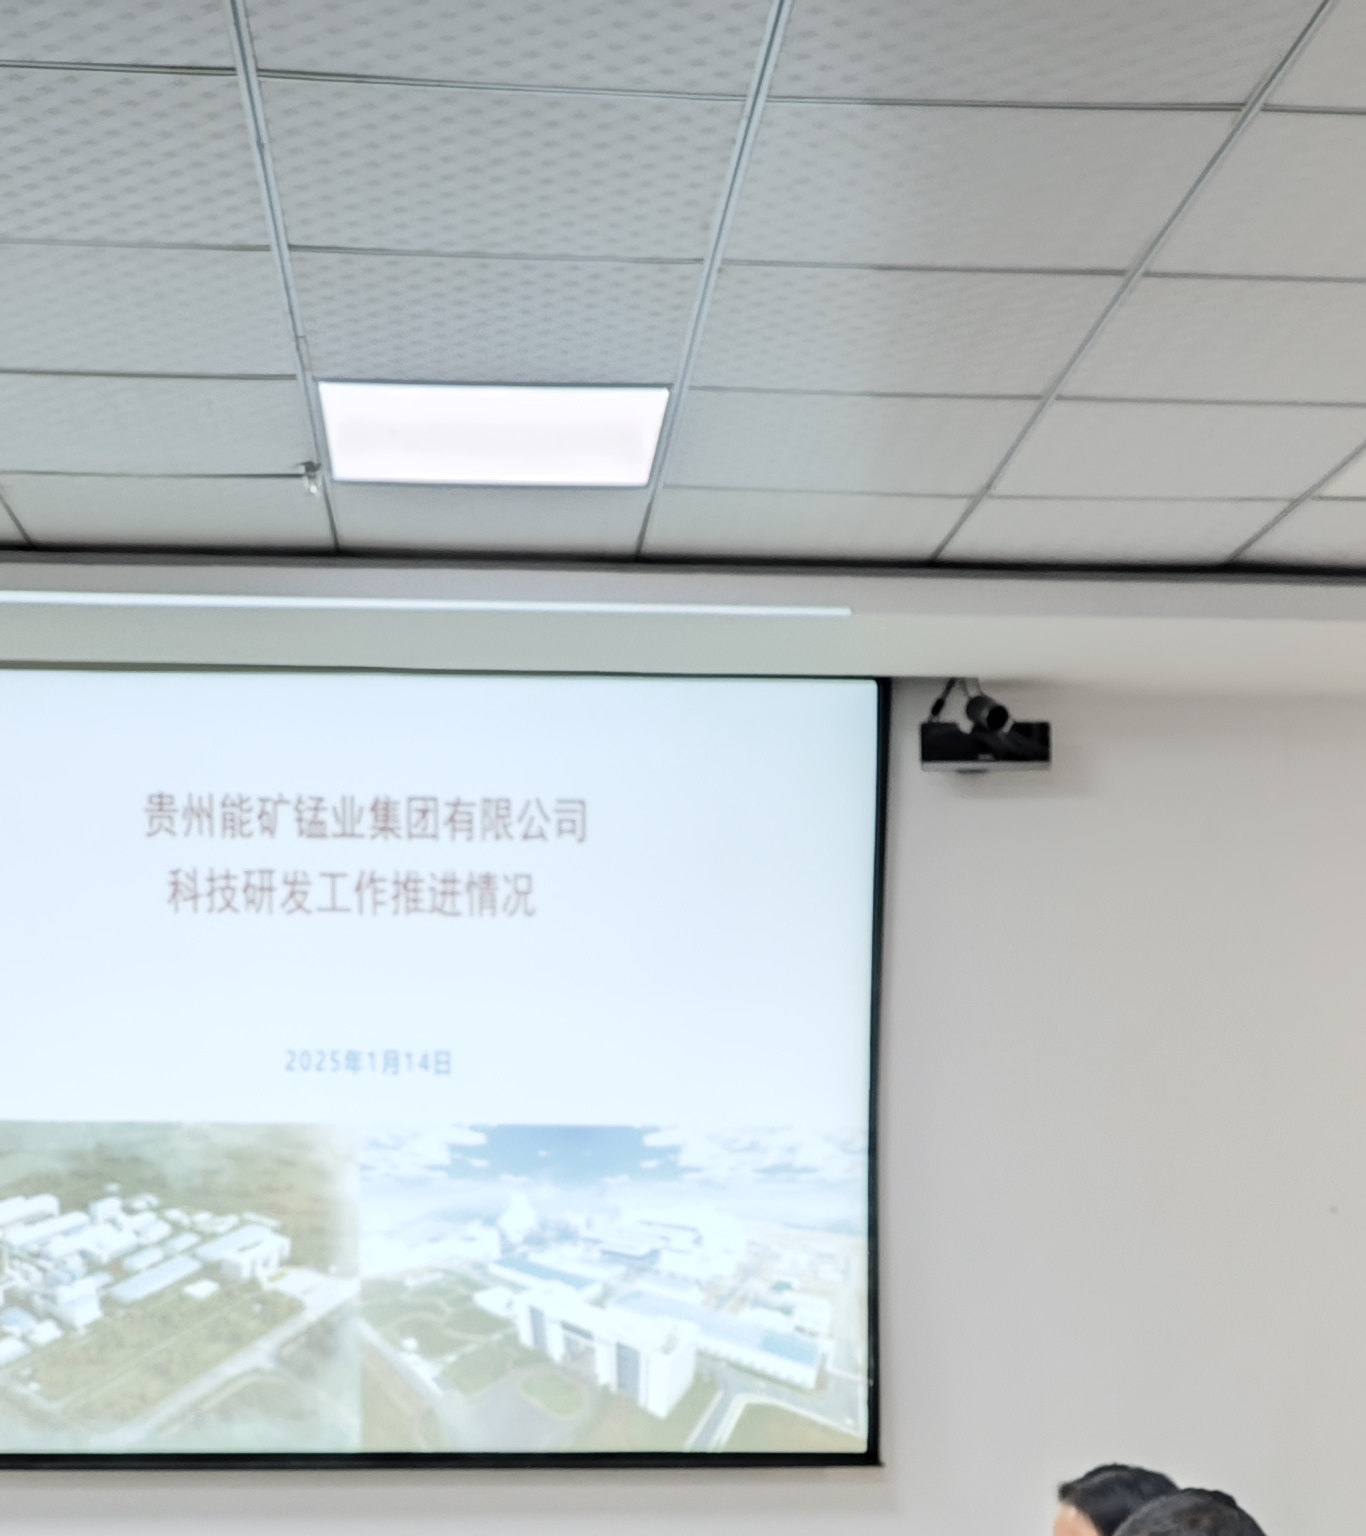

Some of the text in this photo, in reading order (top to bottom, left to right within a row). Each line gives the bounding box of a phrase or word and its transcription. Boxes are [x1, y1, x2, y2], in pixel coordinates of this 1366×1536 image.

[143, 791, 588, 845] 贵州能矿锰业集团有限公司
[167, 868, 537, 919] 科技研发工作推进情况
[284, 1047, 453, 1077] 2025年1月14日
